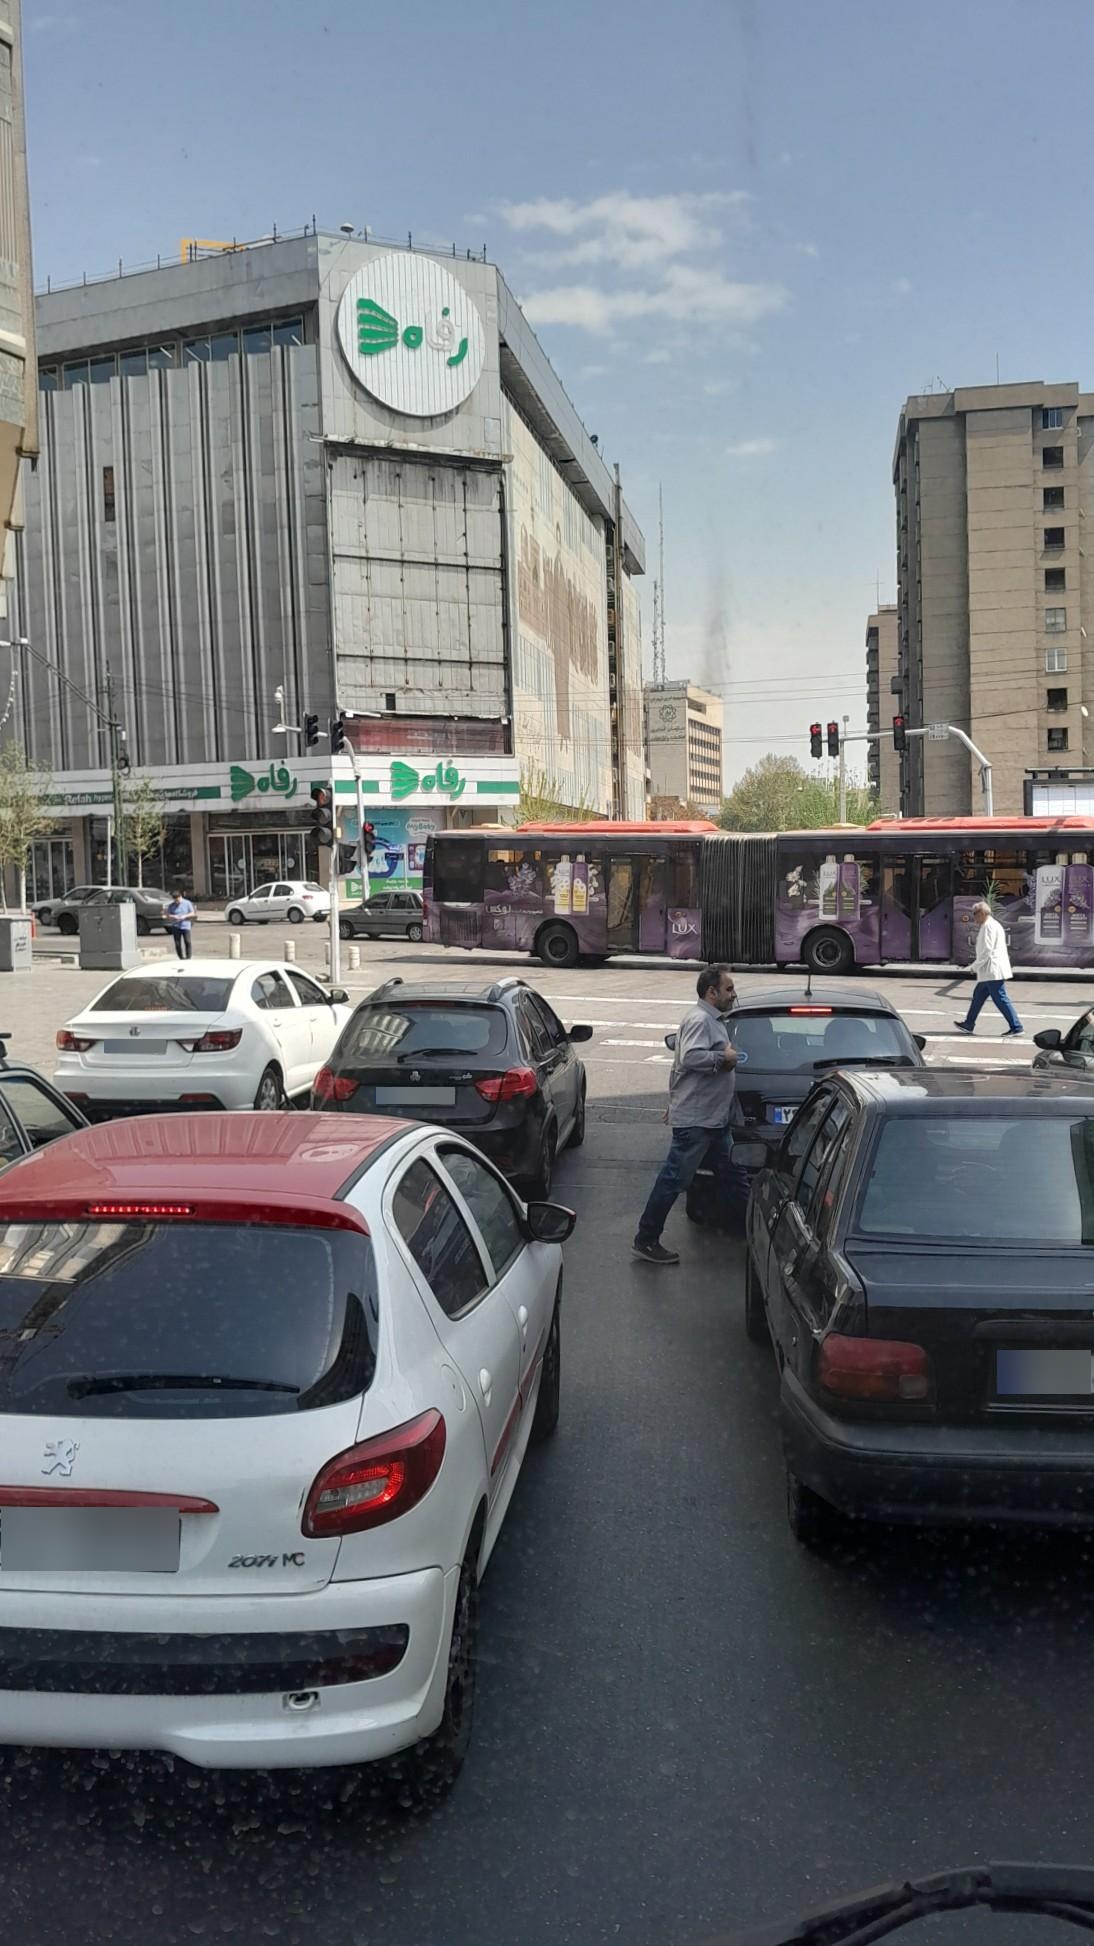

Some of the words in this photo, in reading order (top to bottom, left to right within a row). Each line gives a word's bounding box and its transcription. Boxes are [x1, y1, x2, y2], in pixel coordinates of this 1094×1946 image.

[402, 307, 468, 366] رفاه
[257, 759, 298, 799] رفاه
[421, 759, 466, 801] رفاه
[672, 922, 698, 935] LUX
[282, 1552, 305, 1567] MC
